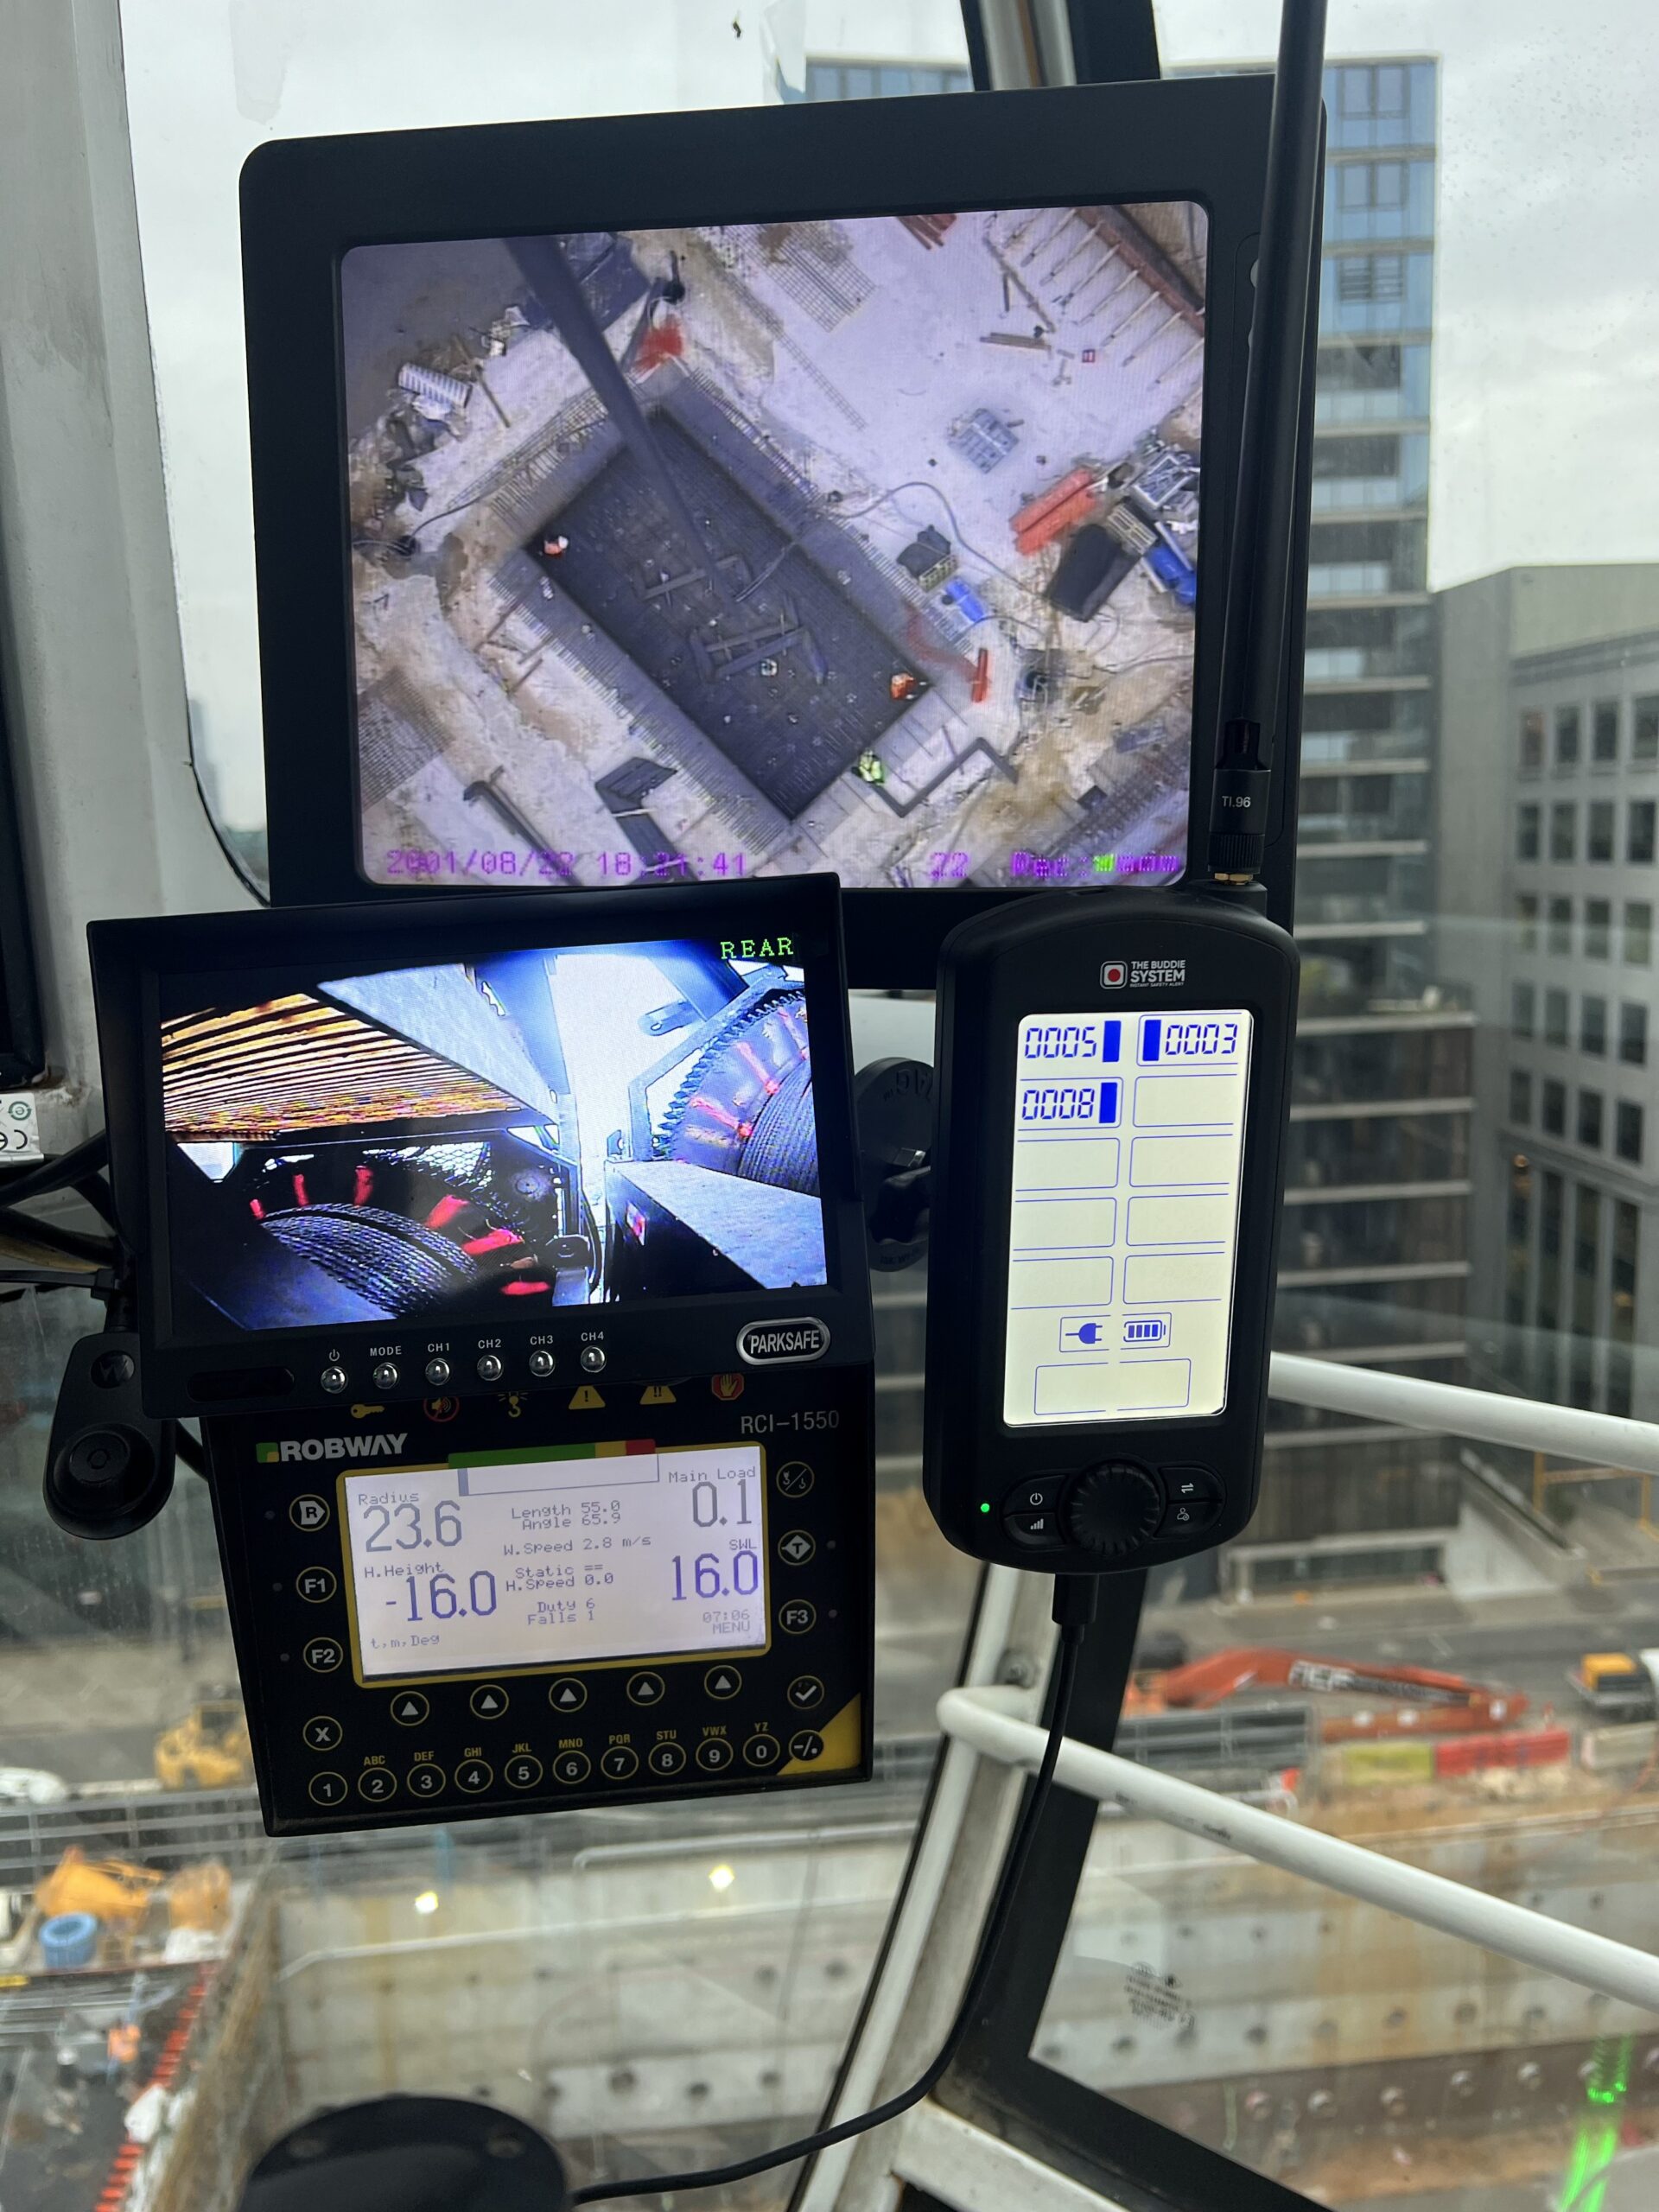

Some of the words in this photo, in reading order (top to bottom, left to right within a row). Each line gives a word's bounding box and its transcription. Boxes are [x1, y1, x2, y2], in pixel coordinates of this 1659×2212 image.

[720, 937, 794, 959] REAR
[1130, 961, 1149, 969] THE
[1150, 959, 1186, 969] BUDDIE
[1130, 969, 1185, 983] SYSTEM
[1025, 1027, 1097, 1058] 0005
[1166, 1023, 1238, 1055] 0003
[1021, 1088, 1095, 1120] 0008
[478, 1338, 502, 1350] CH2
[530, 1335, 554, 1345] CH3
[581, 1332, 605, 1342] CH4
[750, 1330, 820, 1354] PARKSAFE
[370, 1345, 403, 1357] MODE
[427, 1343, 451, 1353] CH1
[741, 1410, 840, 1434] RCI-1550
[280, 1433, 408, 1462] ROBWAY
[669, 1471, 707, 1483] Main
[717, 1466, 755, 1480] Load
[358, 1492, 419, 1506] Radius
[692, 1478, 752, 1528] 0.1
[511, 1503, 571, 1519] Length
[581, 1499, 620, 1513] 55.0
[363, 1500, 462, 1553] 23.6
[522, 1516, 571, 1531] Angle
[582, 1512, 620, 1526] 65.9
[504, 1540, 573, 1555] W.Speed
[582, 1536, 612, 1550] 2.8
[622, 1535, 651, 1548] m/s
[729, 1538, 758, 1551] SWL
[365, 1562, 444, 1579] H.Height
[515, 1564, 574, 1580] Static
[671, 1550, 759, 1601] 16.0
[304, 1579, 326, 1593] F1
[505, 1576, 575, 1592] H.Speed
[585, 1572, 613, 1586] 0.0
[386, 1570, 497, 1622] -16.0
[537, 1600, 575, 1613] Duty
[586, 1598, 595, 1610] 6
[527, 1612, 577, 1625] Falls
[588, 1611, 594, 1621] 1
[702, 1609, 750, 1624] 07:06
[786, 1610, 809, 1624] F3
[713, 1620, 750, 1635] MENU
[311, 1649, 335, 1663] F2
[702, 1726, 727, 1737] VWX
[754, 1722, 768, 1732] YZ
[656, 1729, 677, 1740] STU
[512, 1743, 532, 1753] JKL
[558, 1738, 583, 1748] MNO
[414, 1751, 435, 1762] DEF
[464, 1747, 482, 1758] GHI
[709, 1749, 721, 1764] 9
[756, 1745, 767, 1759] 0
[363, 1755, 386, 1766] ABC
[613, 1758, 626, 1771] 7
[661, 1753, 674, 1767] 8
[518, 1766, 530, 1781] 5
[566, 1762, 578, 1776] 6
[421, 1775, 432, 1789] 3
[467, 1770, 480, 1785] 4
[322, 1783, 332, 1797] 1
[372, 1779, 384, 1794] 2
